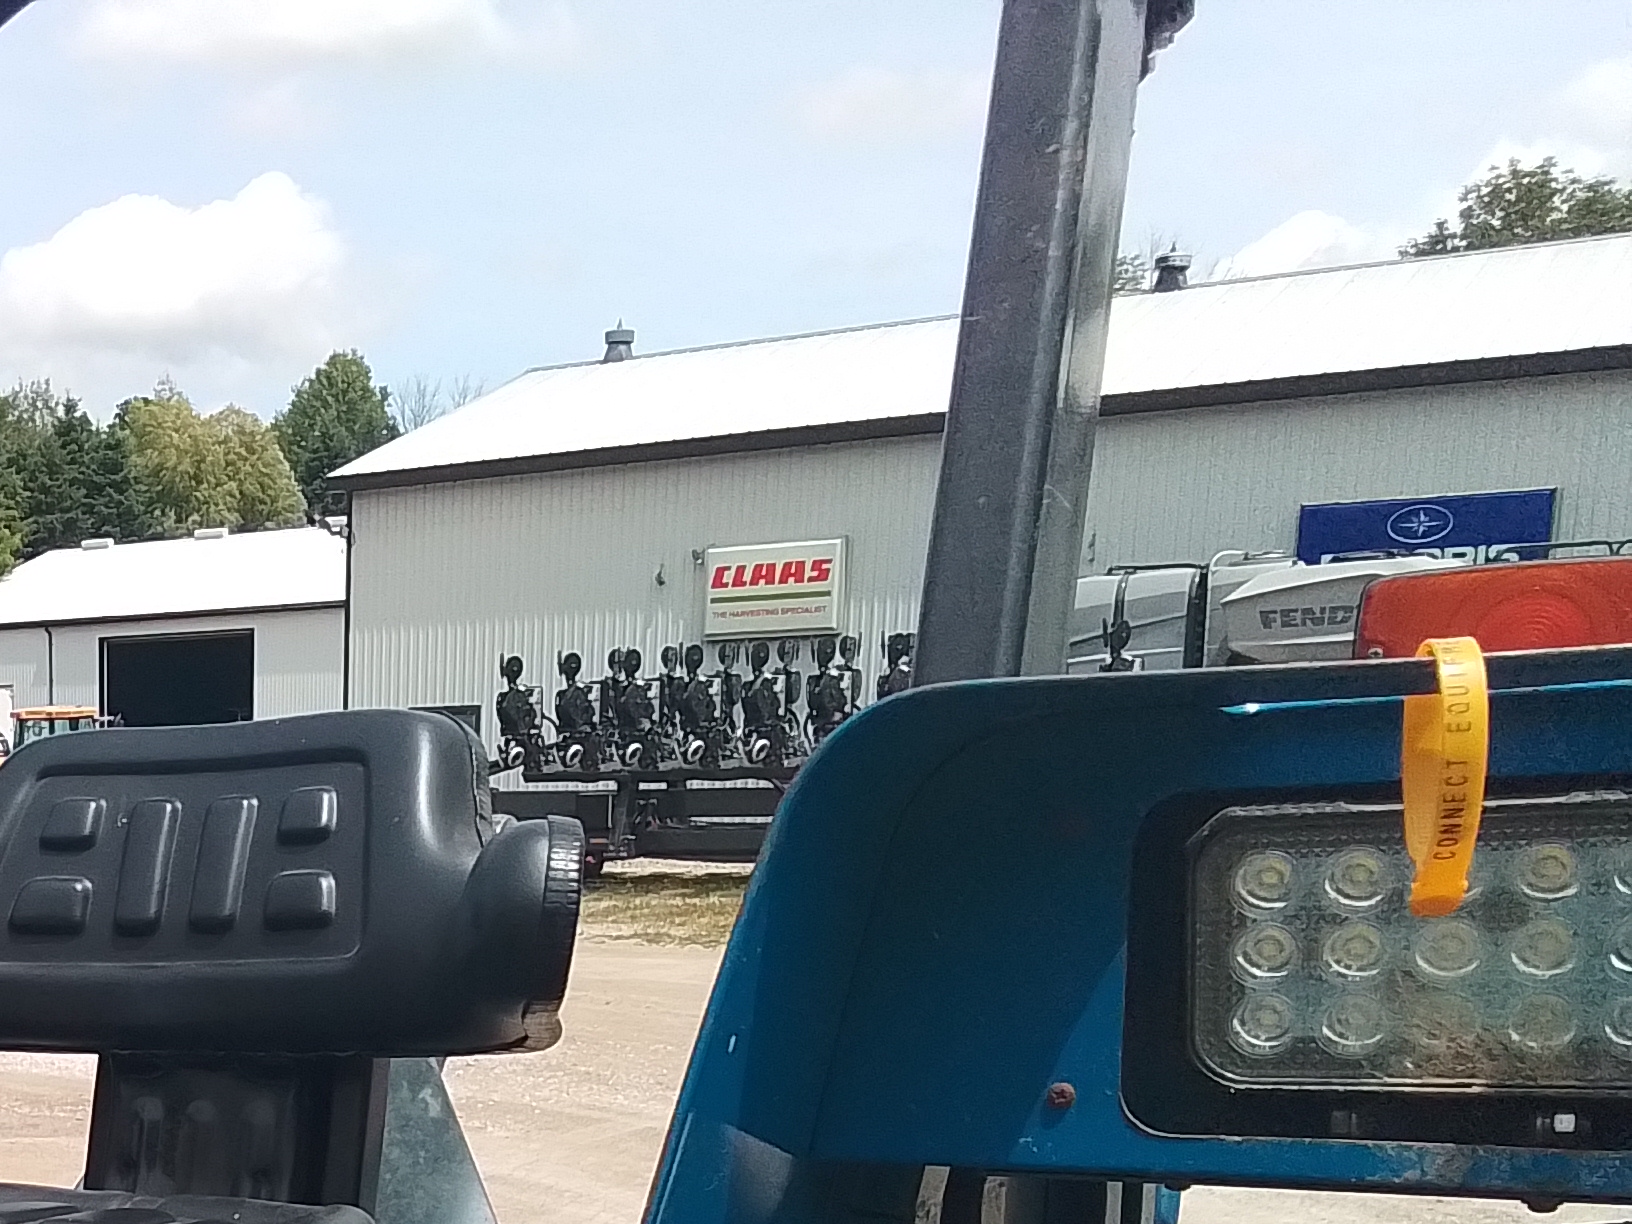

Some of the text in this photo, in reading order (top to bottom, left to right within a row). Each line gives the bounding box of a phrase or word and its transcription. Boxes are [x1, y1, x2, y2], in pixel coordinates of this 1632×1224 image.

[710, 558, 834, 590] CLAAS
[712, 605, 827, 619] THE HARVESTING SPECIALIST
[1259, 604, 1357, 630] FEND
[1433, 758, 1469, 861] CONNECT
